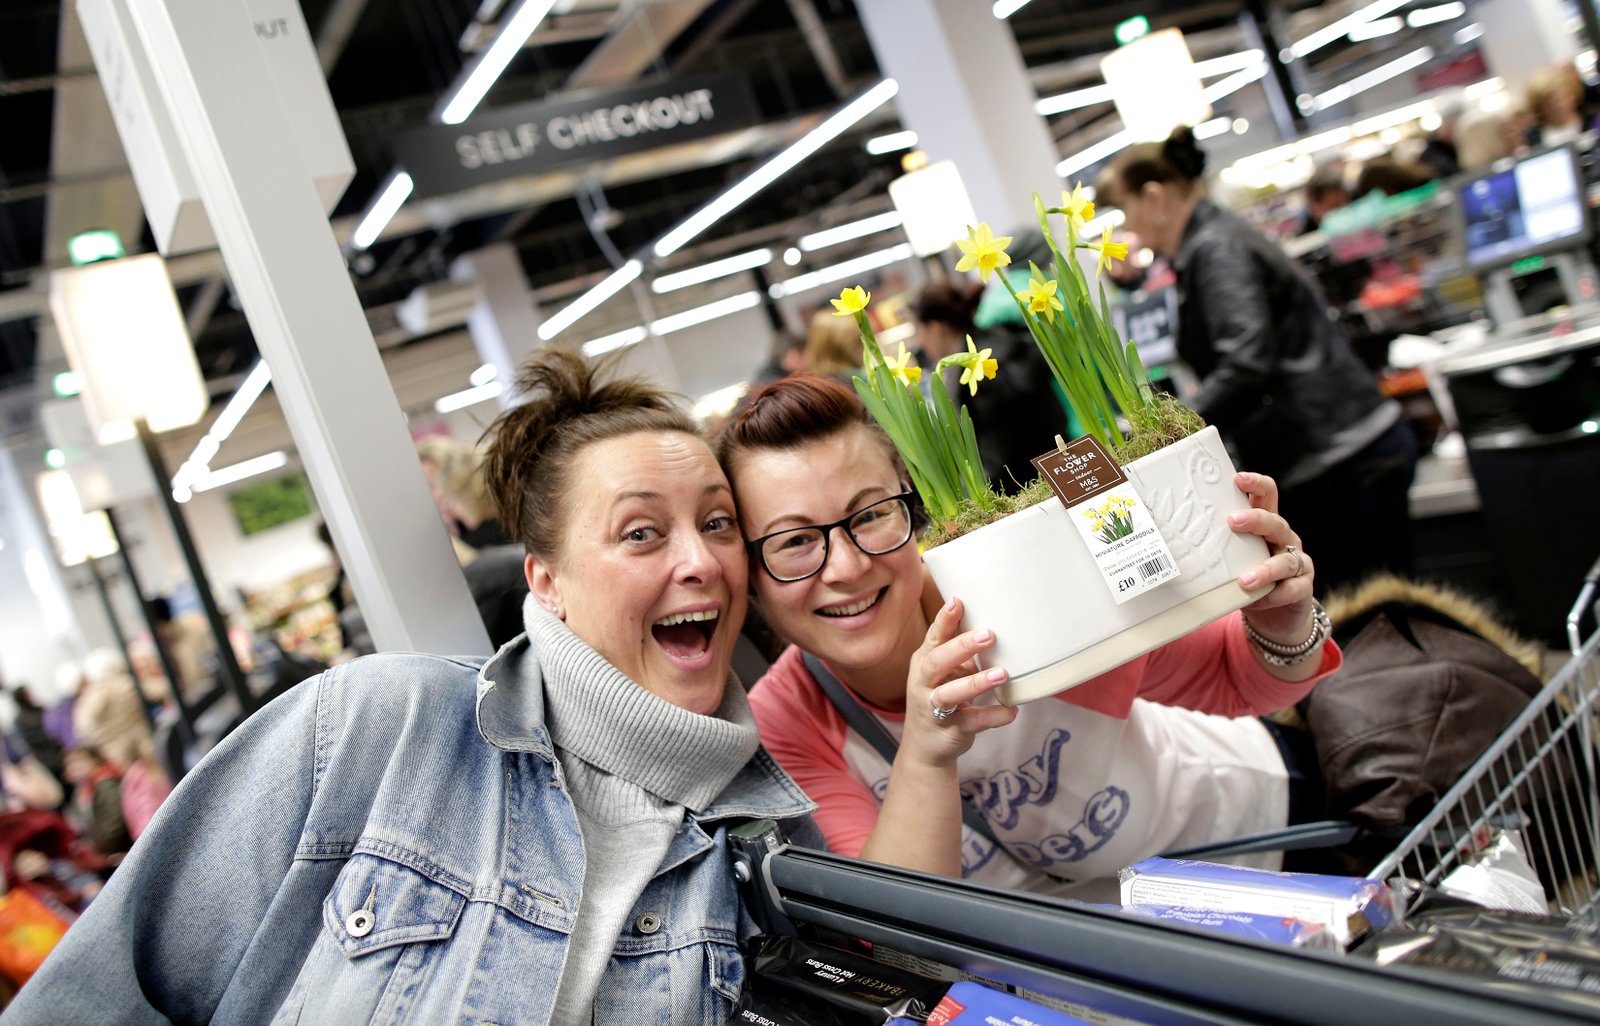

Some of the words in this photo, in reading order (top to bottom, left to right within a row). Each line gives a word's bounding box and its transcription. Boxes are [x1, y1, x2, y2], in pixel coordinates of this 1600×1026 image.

[253, 18, 288, 39] UT
[455, 122, 542, 169] SELF
[546, 88, 715, 151] CHECKOUT
[1053, 452, 1097, 475] FLOWER
[1063, 454, 1077, 462] THE
[1070, 463, 1088, 475] SHOP
[1079, 476, 1099, 489] M&S
[1095, 542, 1125, 559] MINIATURE
[1125, 528, 1155, 545] DAFFODILS
[1118, 576, 1136, 593] £10
[805, 958, 824, 969] Buns
[822, 964, 842, 974] Cross
[814, 970, 840, 983] Luxury
[840, 970, 856, 979] Hot
[855, 976, 901, 995] BAKERY
[741, 1010, 759, 1023] Buns
